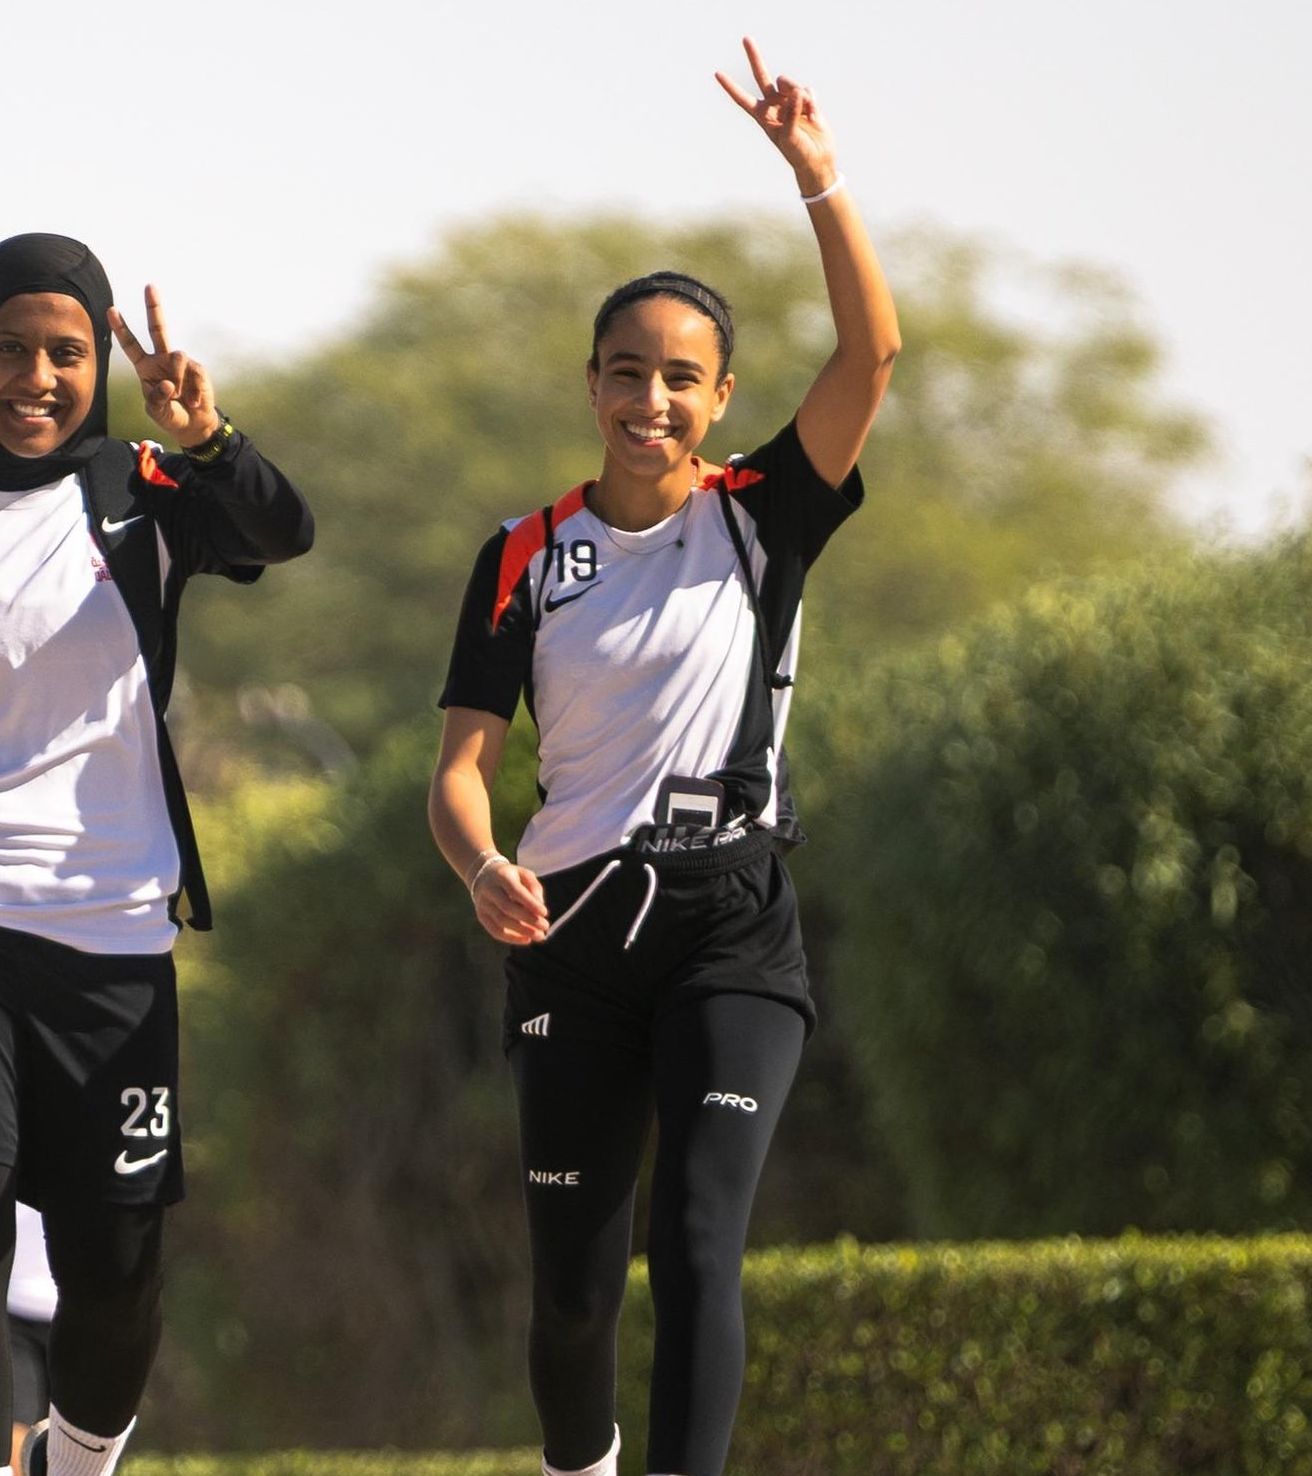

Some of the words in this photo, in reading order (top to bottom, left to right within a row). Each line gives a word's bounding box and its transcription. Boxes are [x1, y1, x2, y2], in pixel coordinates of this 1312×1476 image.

[553, 539, 597, 582] 19
[640, 834, 710, 853] NIKE
[120, 1086, 169, 1137] 23
[703, 1092, 758, 1112] PRO
[528, 1169, 580, 1185] NIKE
